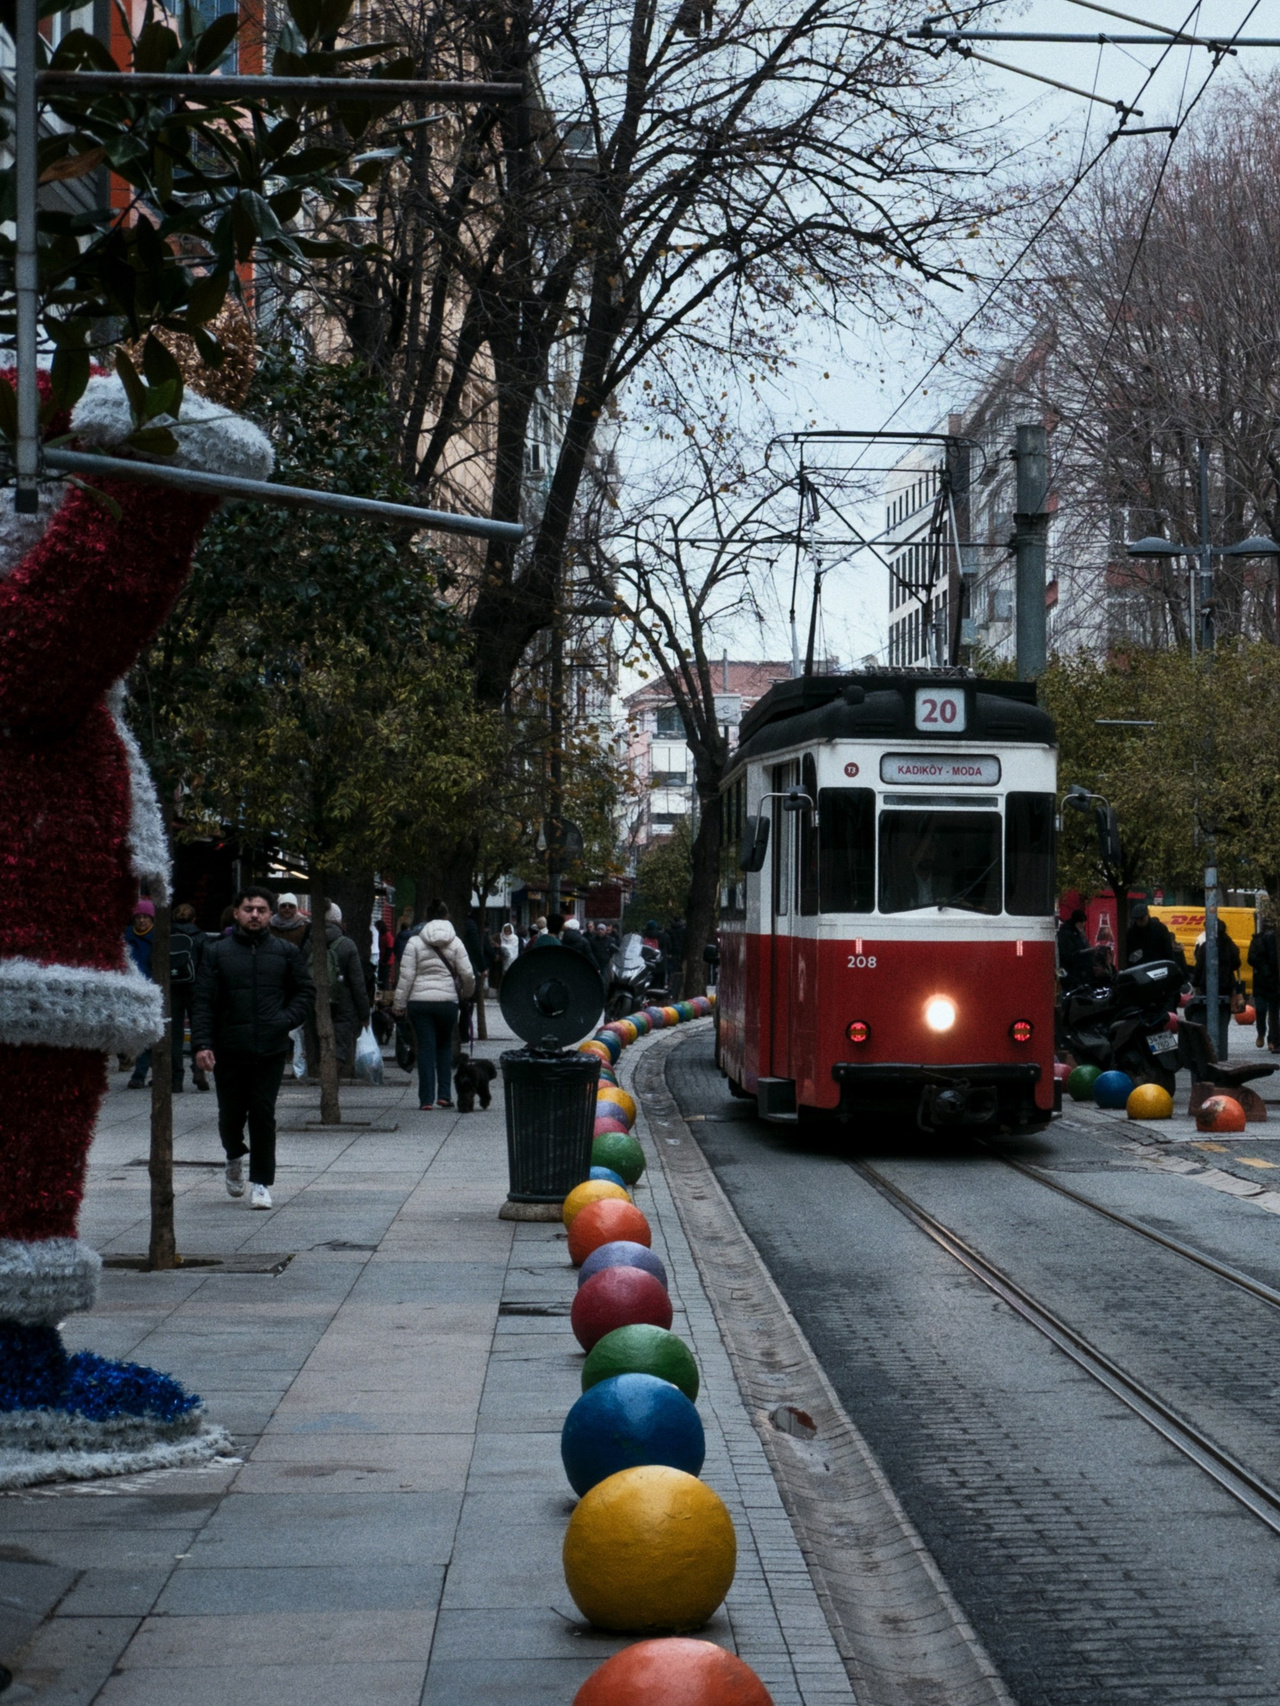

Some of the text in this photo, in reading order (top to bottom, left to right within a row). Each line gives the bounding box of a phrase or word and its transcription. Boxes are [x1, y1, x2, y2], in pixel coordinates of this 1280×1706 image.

[921, 699, 958, 724] 20
[897, 764, 944, 775] KADIKÖY
[952, 766, 982, 776] MODA
[847, 955, 877, 968] 208
